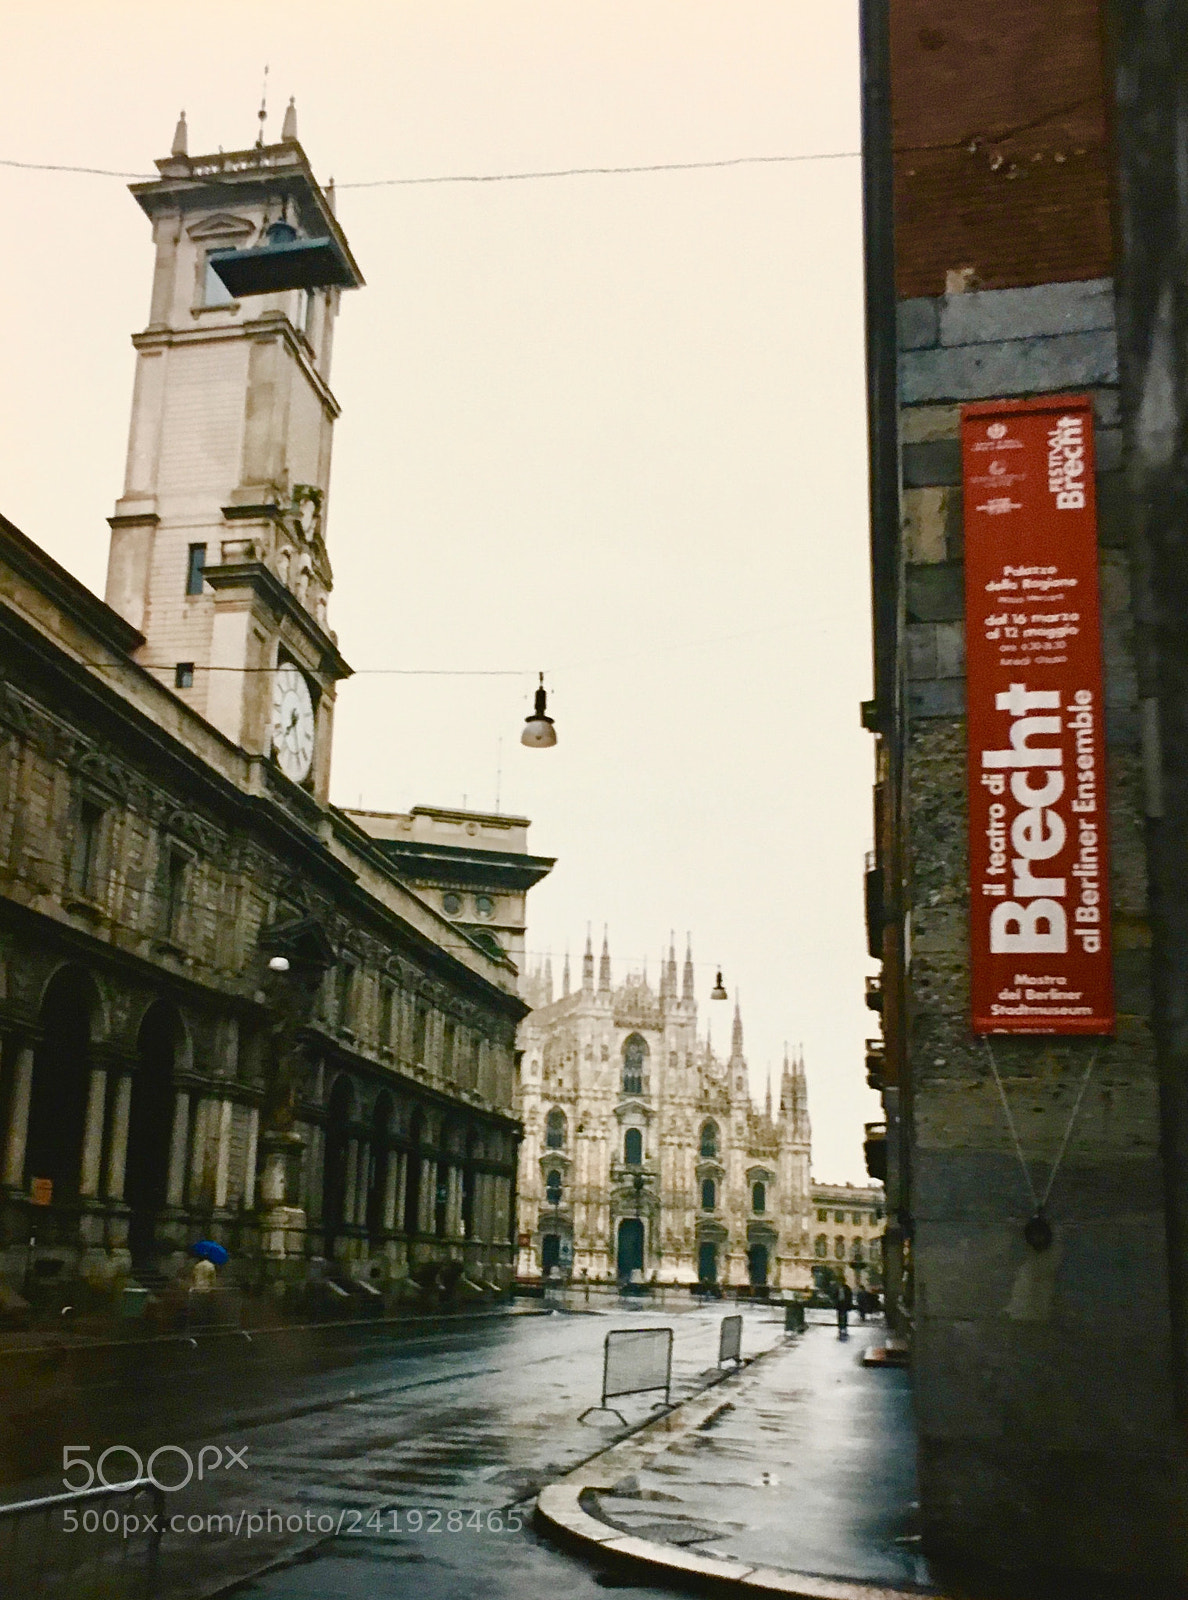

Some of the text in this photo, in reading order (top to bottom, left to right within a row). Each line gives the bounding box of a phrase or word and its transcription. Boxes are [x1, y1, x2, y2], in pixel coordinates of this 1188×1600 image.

[1056, 416, 1085, 510] Brecht
[981, 683, 1068, 954] Brecht
[981, 773, 1007, 897] il teatro di
[1066, 688, 1101, 954] al Berliner Ensemble
[1014, 974, 1067, 985] Mostra
[1025, 988, 1083, 1000] Berliner
